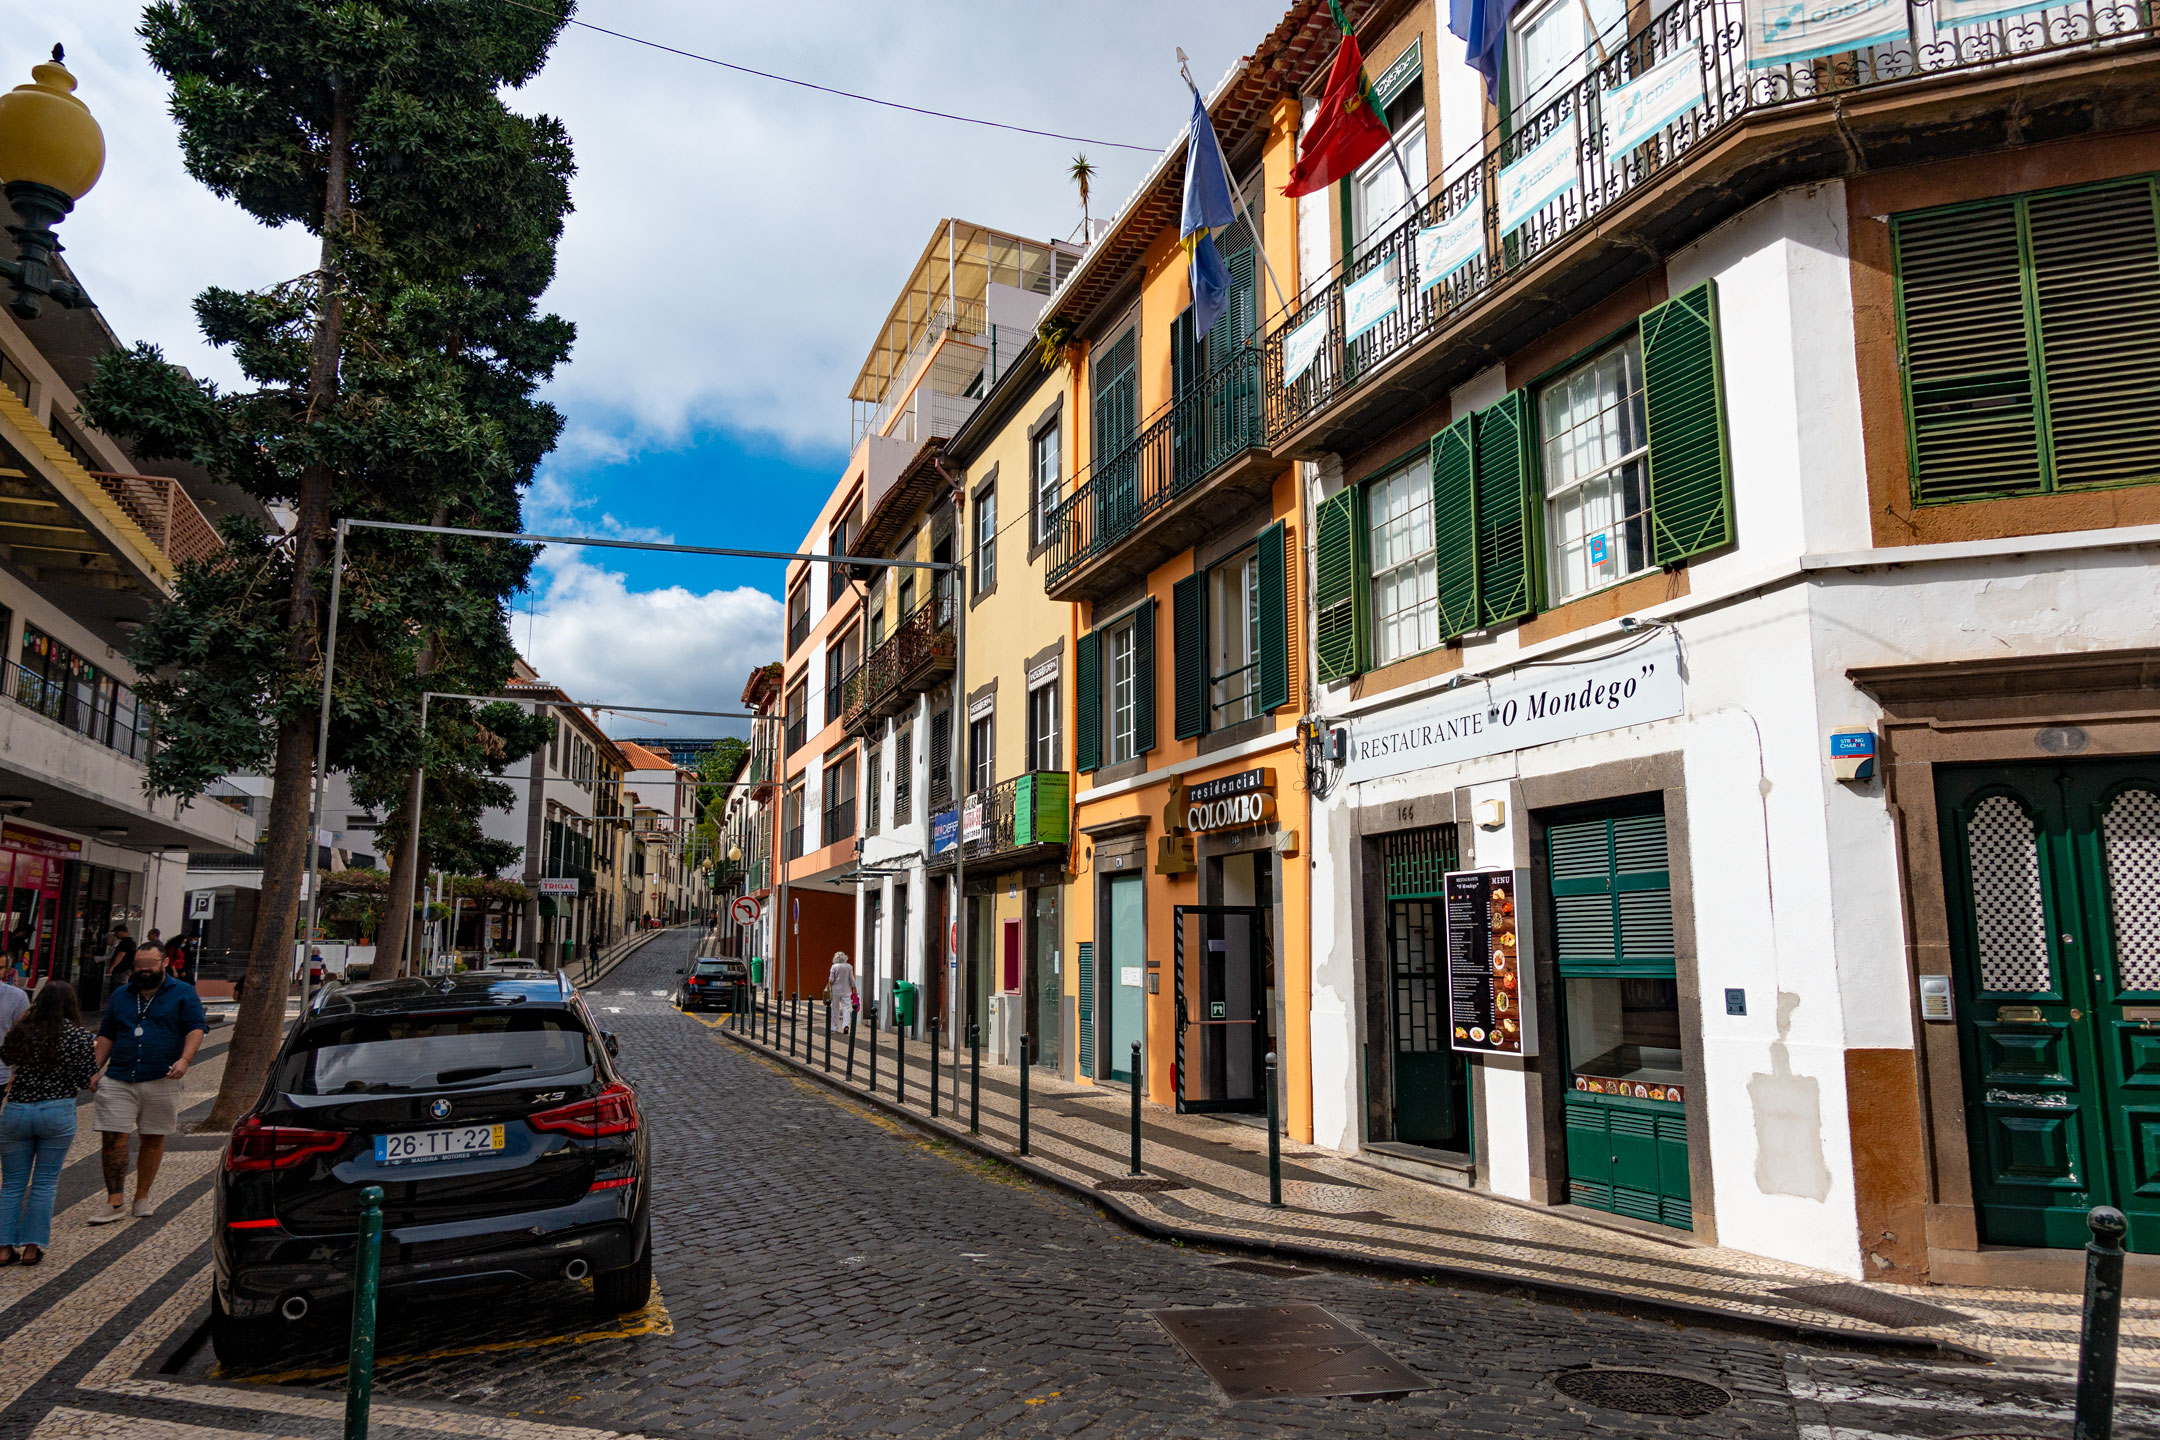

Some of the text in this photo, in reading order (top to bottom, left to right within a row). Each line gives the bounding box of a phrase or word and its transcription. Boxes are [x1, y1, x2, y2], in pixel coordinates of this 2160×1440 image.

[1645, 58, 1698, 105] CDS-PP
[1529, 146, 1572, 187] CDS-PP
[1444, 217, 1479, 250] CDS-PP
[1360, 712, 1483, 760] RESTAURANTE
[1526, 663, 1655, 722] Mondego”
[1191, 769, 1261, 801] residencial
[1187, 793, 1263, 832] COLOMBO
[1398, 805, 1414, 821] 166
[1491, 876, 1510, 885] MENU
[532, 1091, 567, 1104] X3
[411, 1155, 438, 1164] MADEIRA
[441, 1152, 470, 1161] MOTORES
